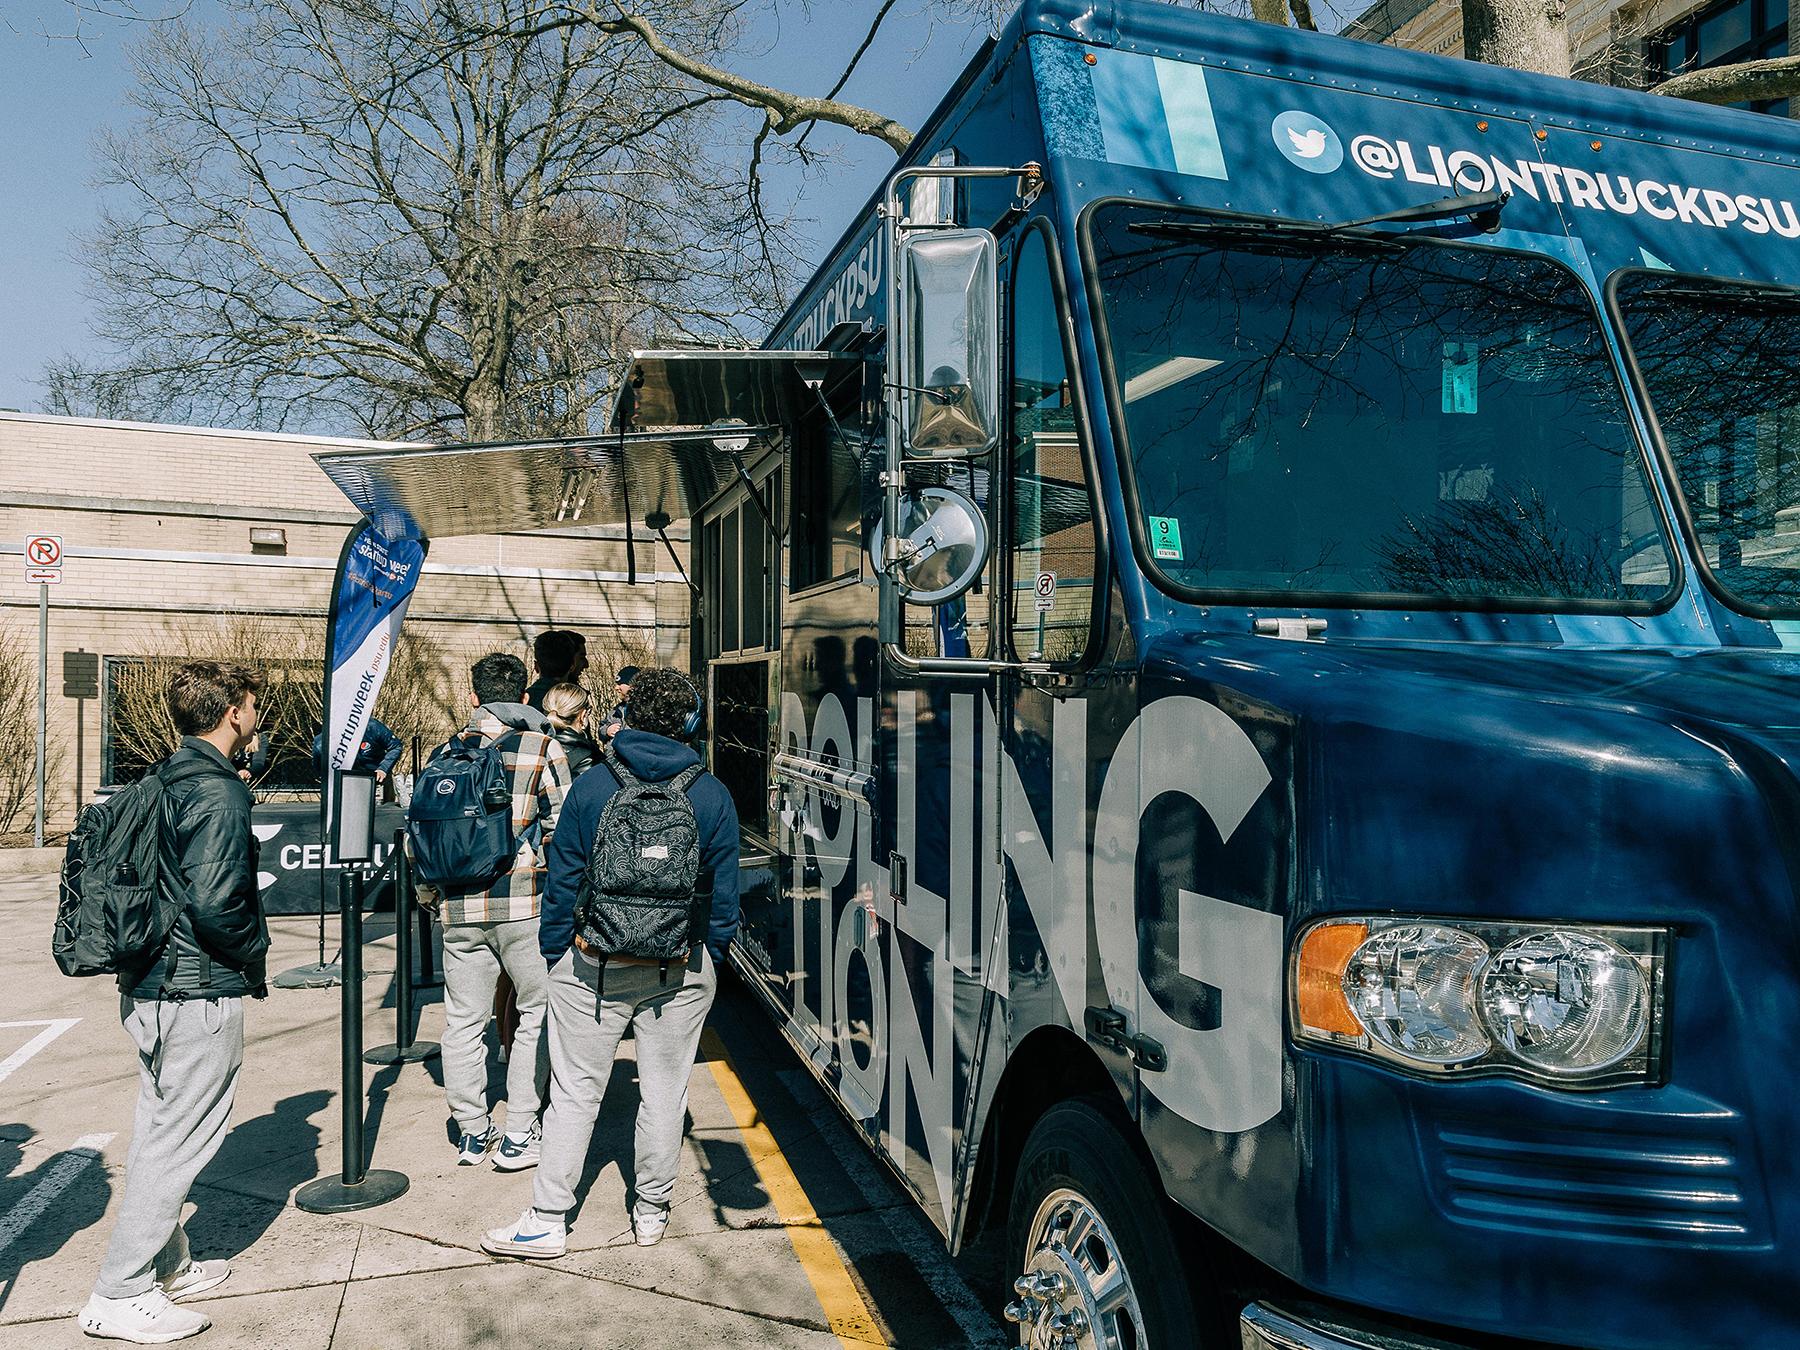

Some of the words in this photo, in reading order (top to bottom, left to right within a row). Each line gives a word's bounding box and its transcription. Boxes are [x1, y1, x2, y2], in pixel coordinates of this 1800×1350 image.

[1350, 134, 1800, 238] @LIONTRUCKPSU
[1160, 521, 1169, 534] 9
[781, 689, 1283, 1133] ROLLING
[793, 858, 953, 1228] LION
